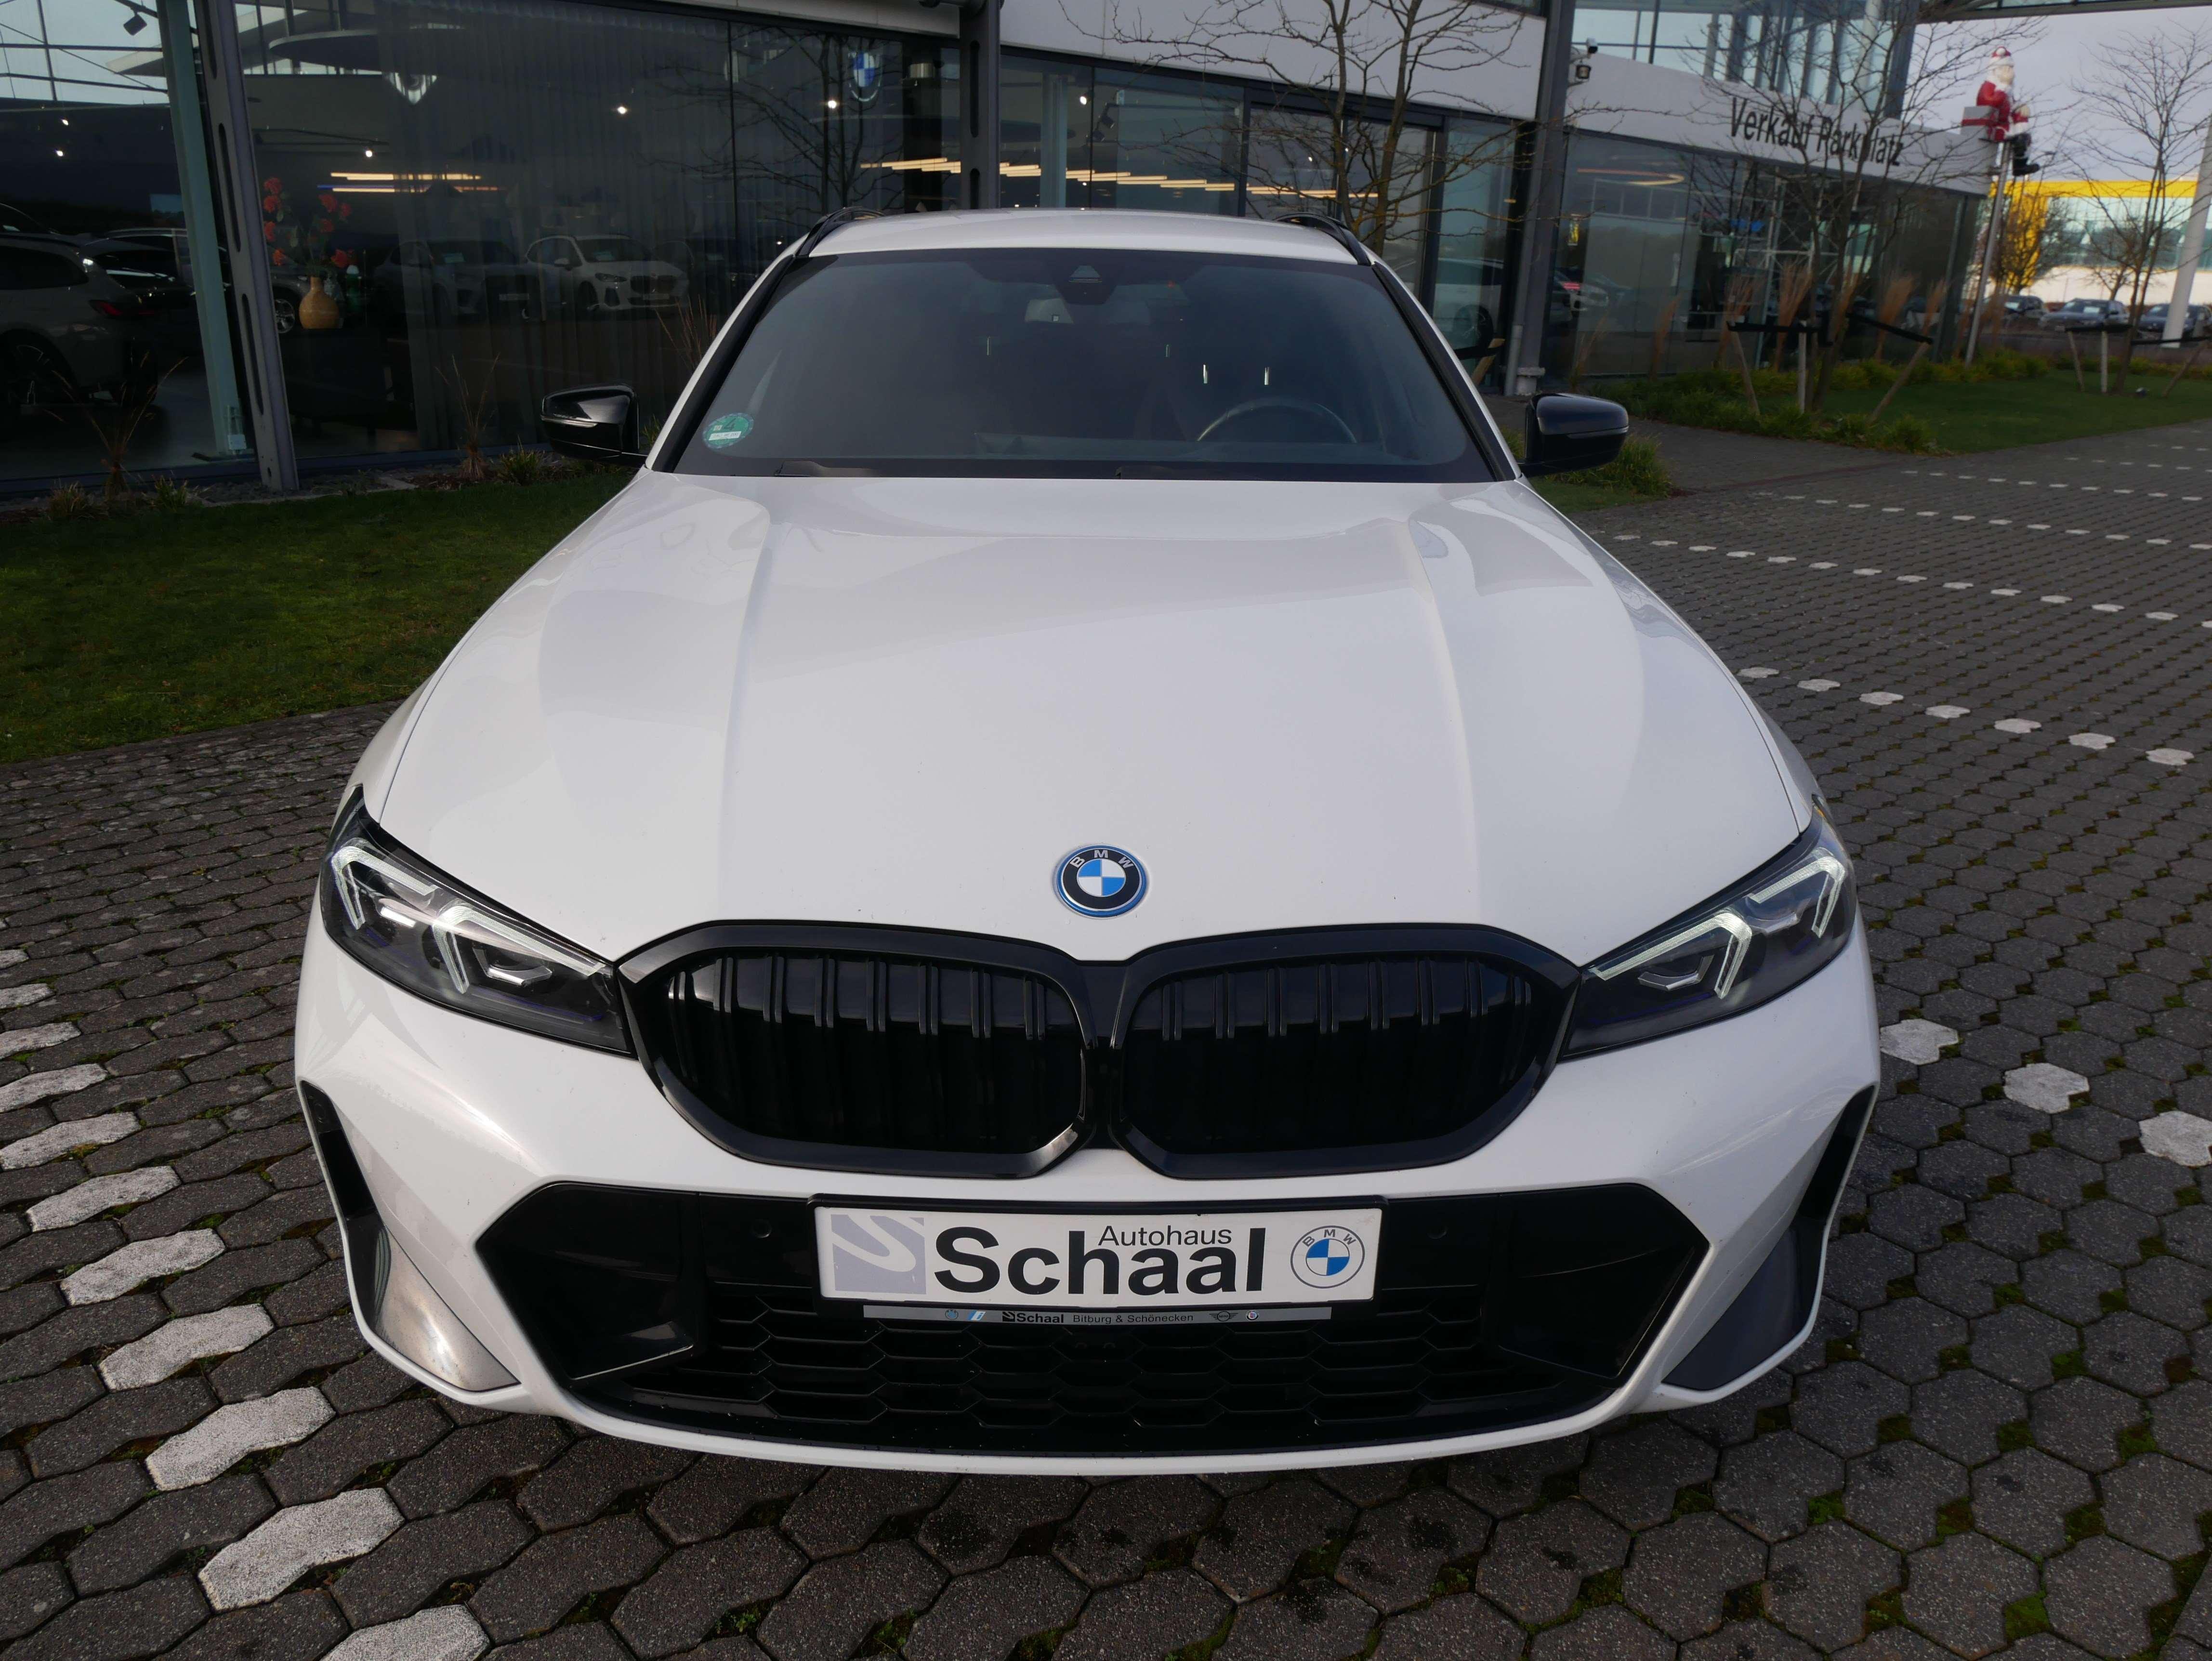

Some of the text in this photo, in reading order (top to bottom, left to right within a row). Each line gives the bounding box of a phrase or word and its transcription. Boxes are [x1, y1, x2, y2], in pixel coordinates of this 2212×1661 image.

[1731, 97, 1903, 166] Verkauf Parklatz
[1070, 850, 1133, 868] BMW
[1098, 1225, 1232, 1246] Autohaus
[1302, 1229, 1356, 1247] BMW
[935, 1226, 1266, 1296] Schaal
[1016, 1313, 1064, 1323] Schaal
[1073, 1315, 1111, 1324] Bitburg
[1127, 1314, 1193, 1322] Schönecken
